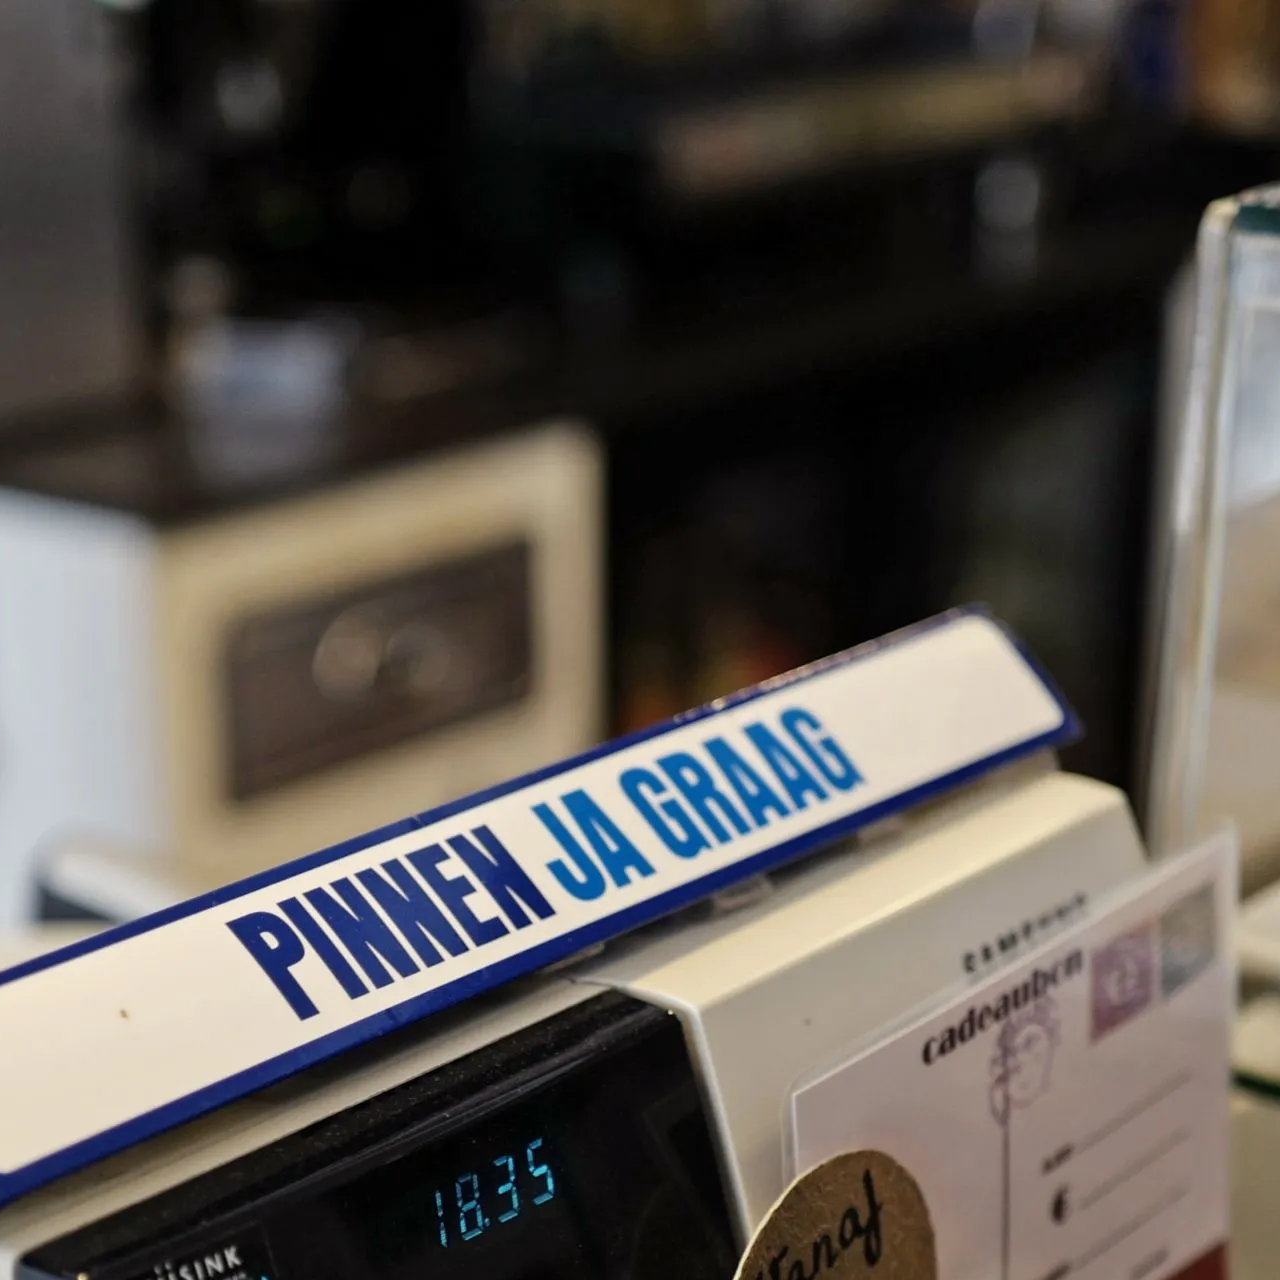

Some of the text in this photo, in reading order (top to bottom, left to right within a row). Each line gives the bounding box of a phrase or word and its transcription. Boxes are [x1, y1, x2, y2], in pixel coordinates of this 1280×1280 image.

[224, 705, 864, 1022] PINNEN JA GRAAG
[922, 950, 1083, 1066] cadeaubon
[436, 1138, 554, 1248] 18.35
